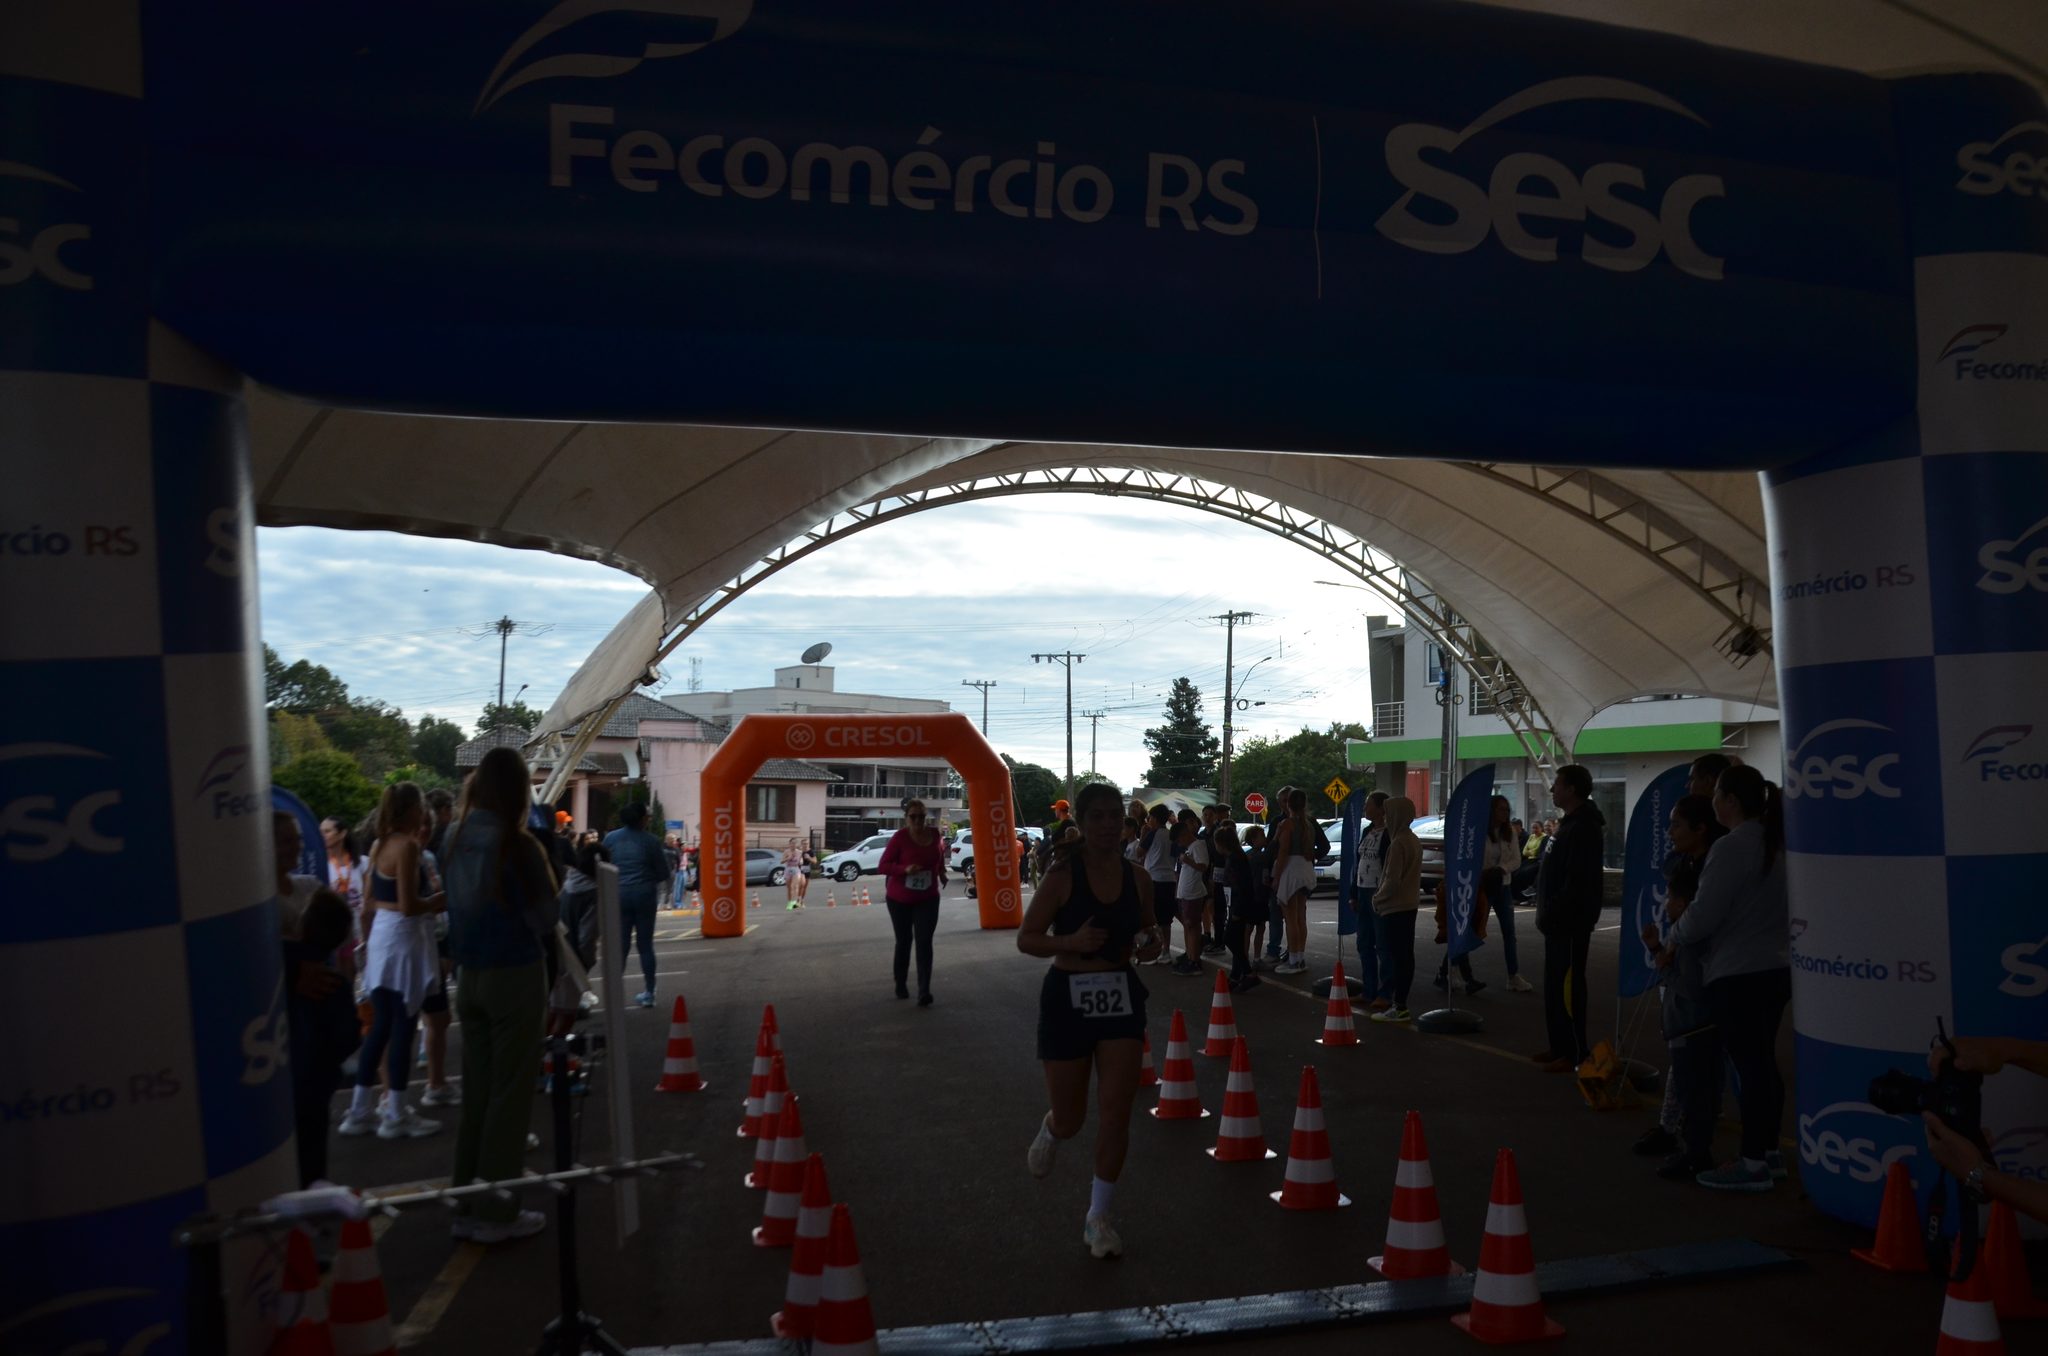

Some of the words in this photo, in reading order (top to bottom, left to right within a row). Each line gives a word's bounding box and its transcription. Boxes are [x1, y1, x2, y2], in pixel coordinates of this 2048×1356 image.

[548, 102, 1115, 224] Fecomércio
[1143, 151, 1260, 236] RS
[1373, 121, 1728, 281] Sesc
[84, 525, 140, 556] RS
[1874, 564, 1916, 588] RS
[824, 725, 933, 747] CRESOL
[1246, 799, 1265, 807] PARE
[714, 799, 734, 891] CRESOL
[989, 792, 1013, 881] CRESOL
[1896, 960, 1938, 983] RS
[1080, 988, 1124, 1015] 582
[129, 1067, 183, 1105] RS
